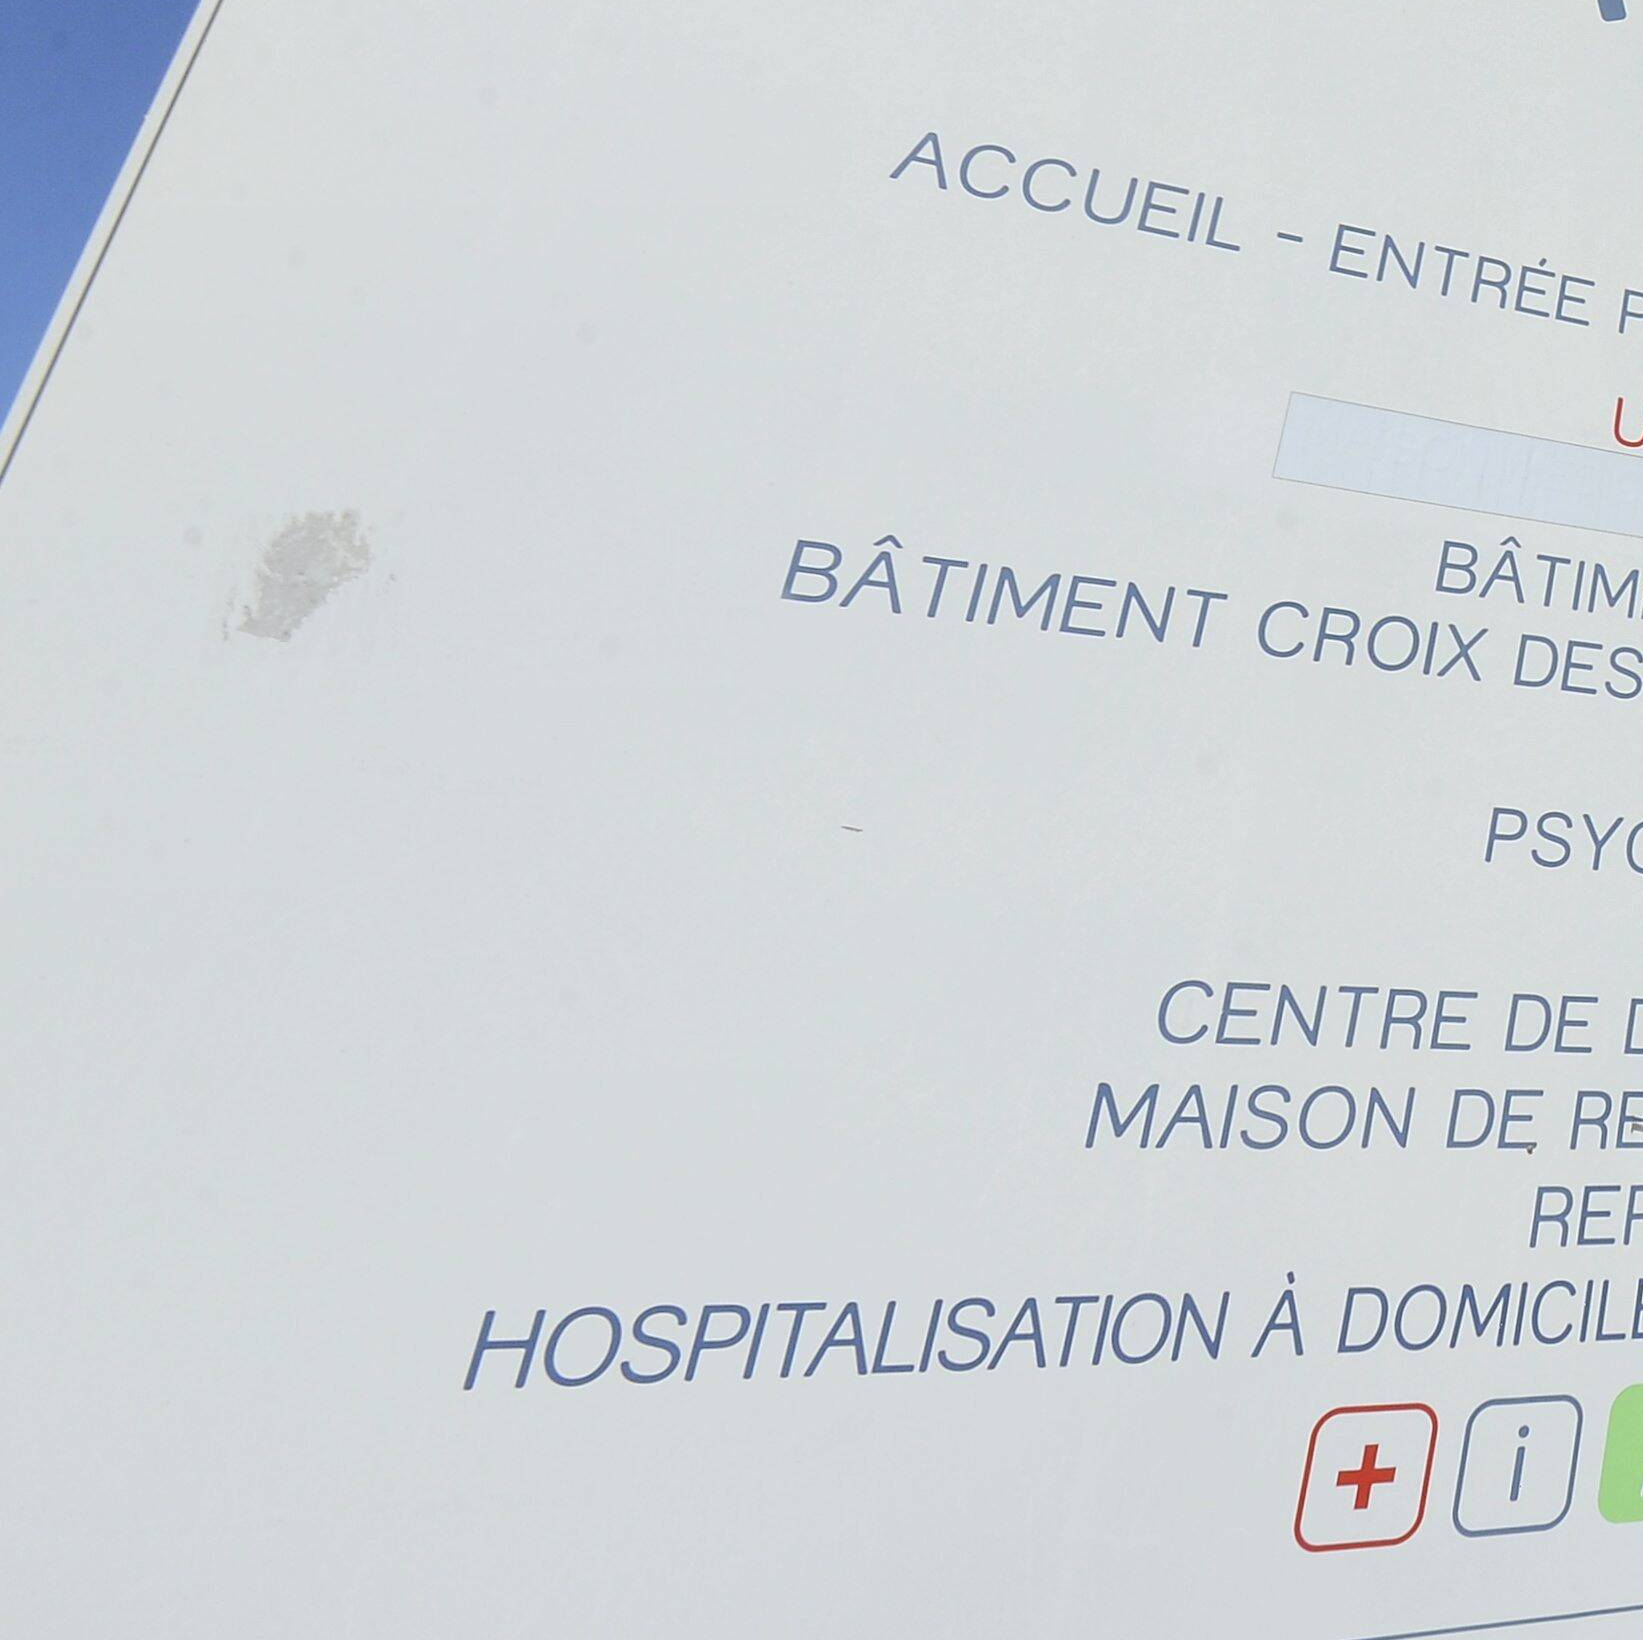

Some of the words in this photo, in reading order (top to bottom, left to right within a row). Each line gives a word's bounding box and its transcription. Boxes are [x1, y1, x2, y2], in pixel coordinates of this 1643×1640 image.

[889, 131, 1241, 253] ACCUEIL
[1328, 225, 1596, 328] ENTRÉE
[779, 534, 1229, 648] BÂTIMENT
[1256, 600, 1490, 682] CROIX
[1157, 979, 1479, 1053] CENTRE
[1503, 993, 1600, 1055] DE
[1084, 1082, 1416, 1151] MAISON
[1445, 1088, 1545, 1151] DE
[463, 1291, 1231, 1391] HOSPITALISATION
[1250, 1270, 1305, 1359] À
